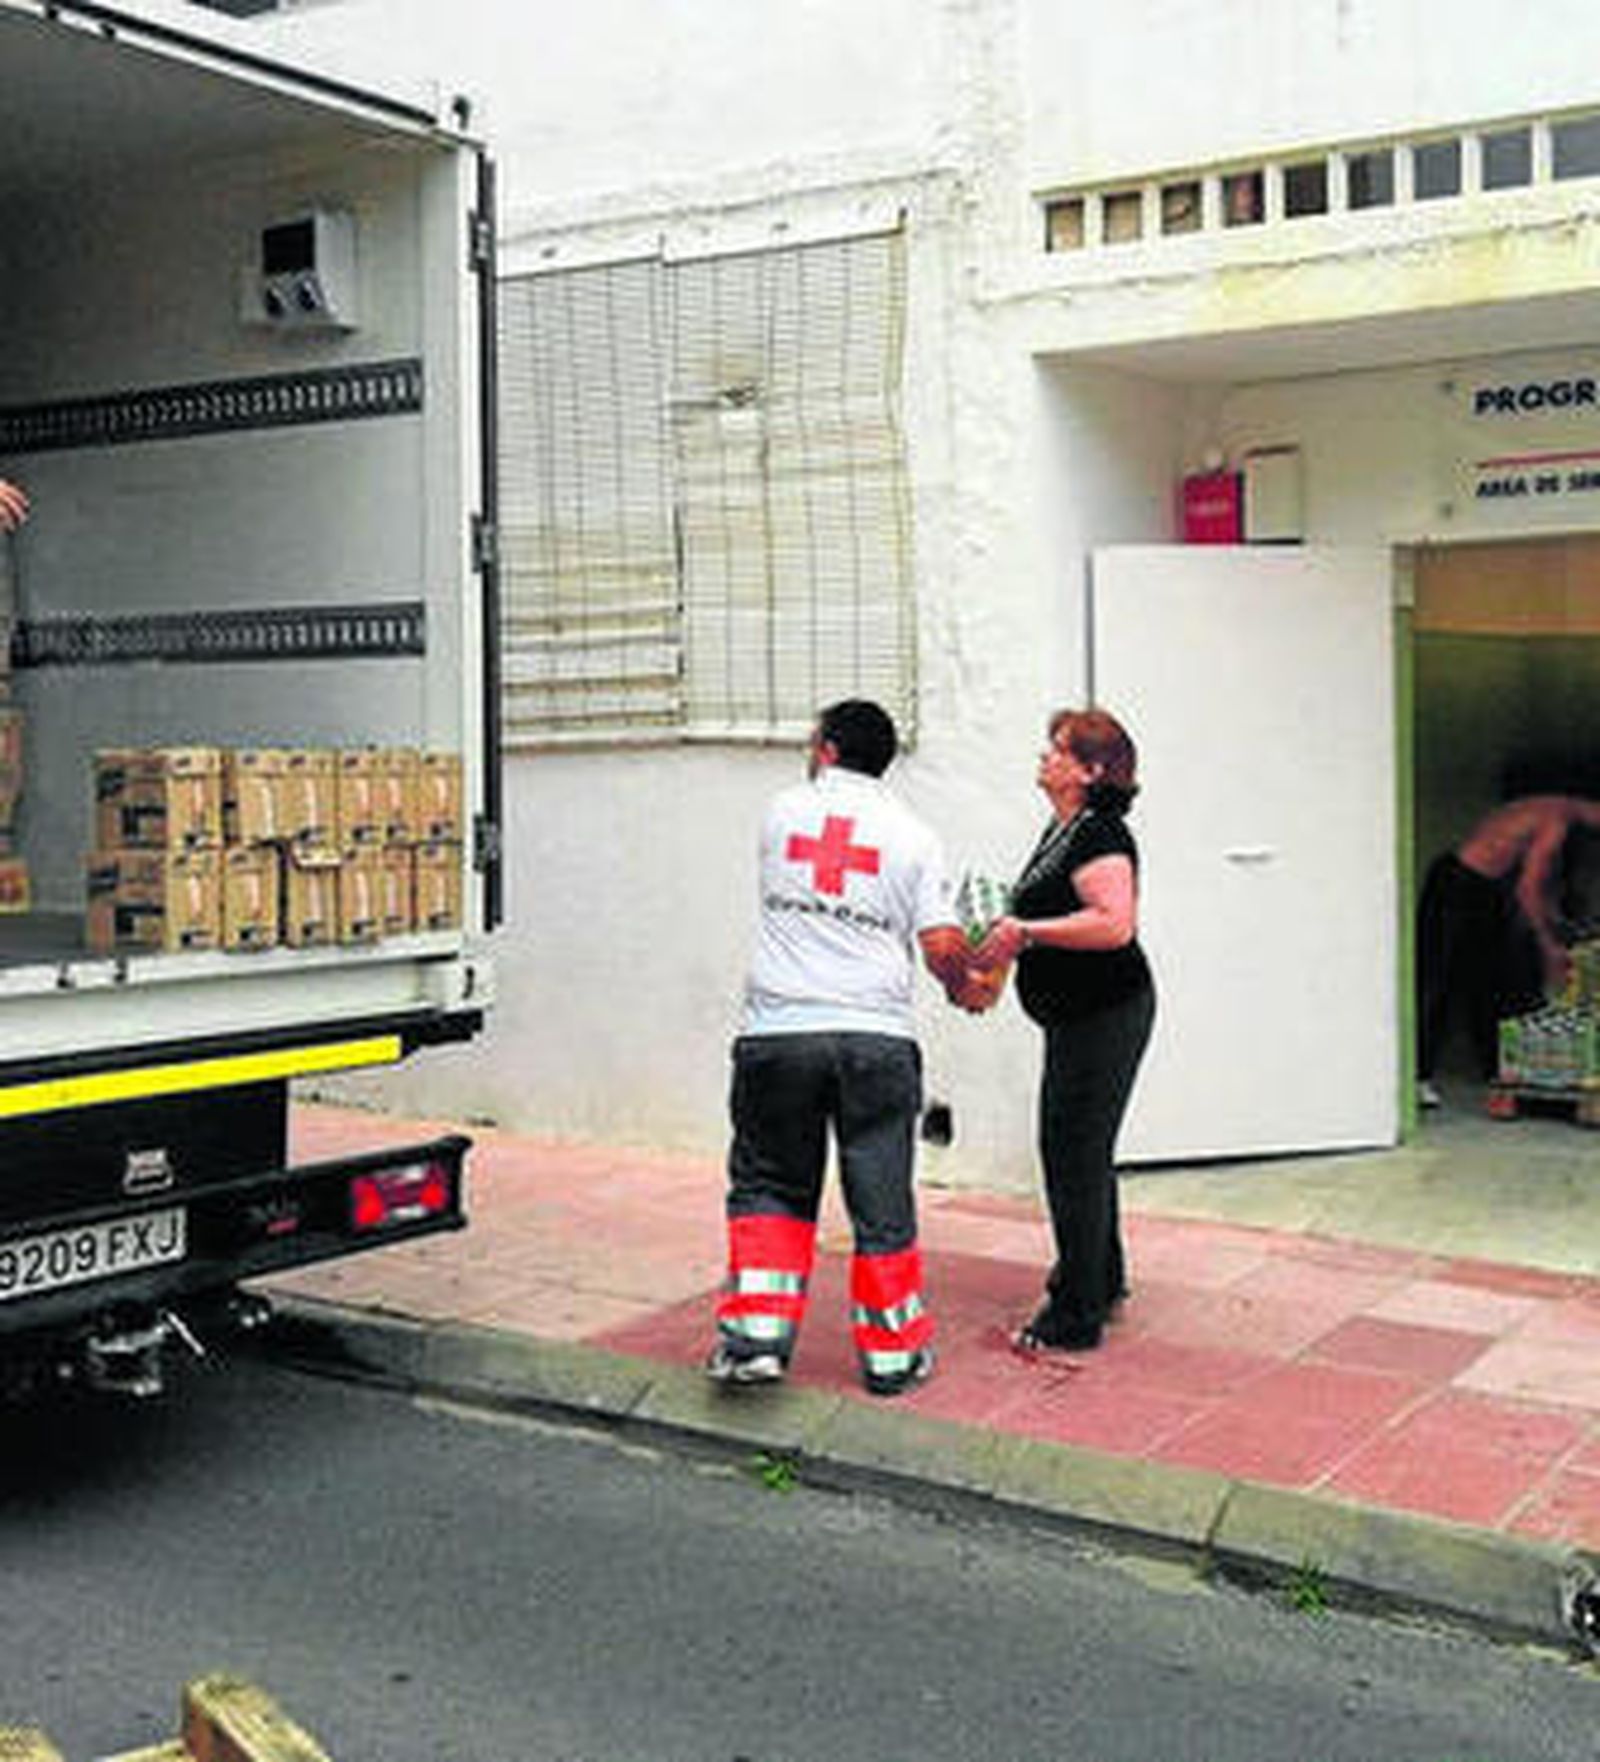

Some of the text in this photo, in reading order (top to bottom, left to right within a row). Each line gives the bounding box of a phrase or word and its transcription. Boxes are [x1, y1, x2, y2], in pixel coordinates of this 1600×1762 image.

[1475, 379, 1595, 414] PROGR
[0, 1212, 177, 1290] 9209 FXJ
